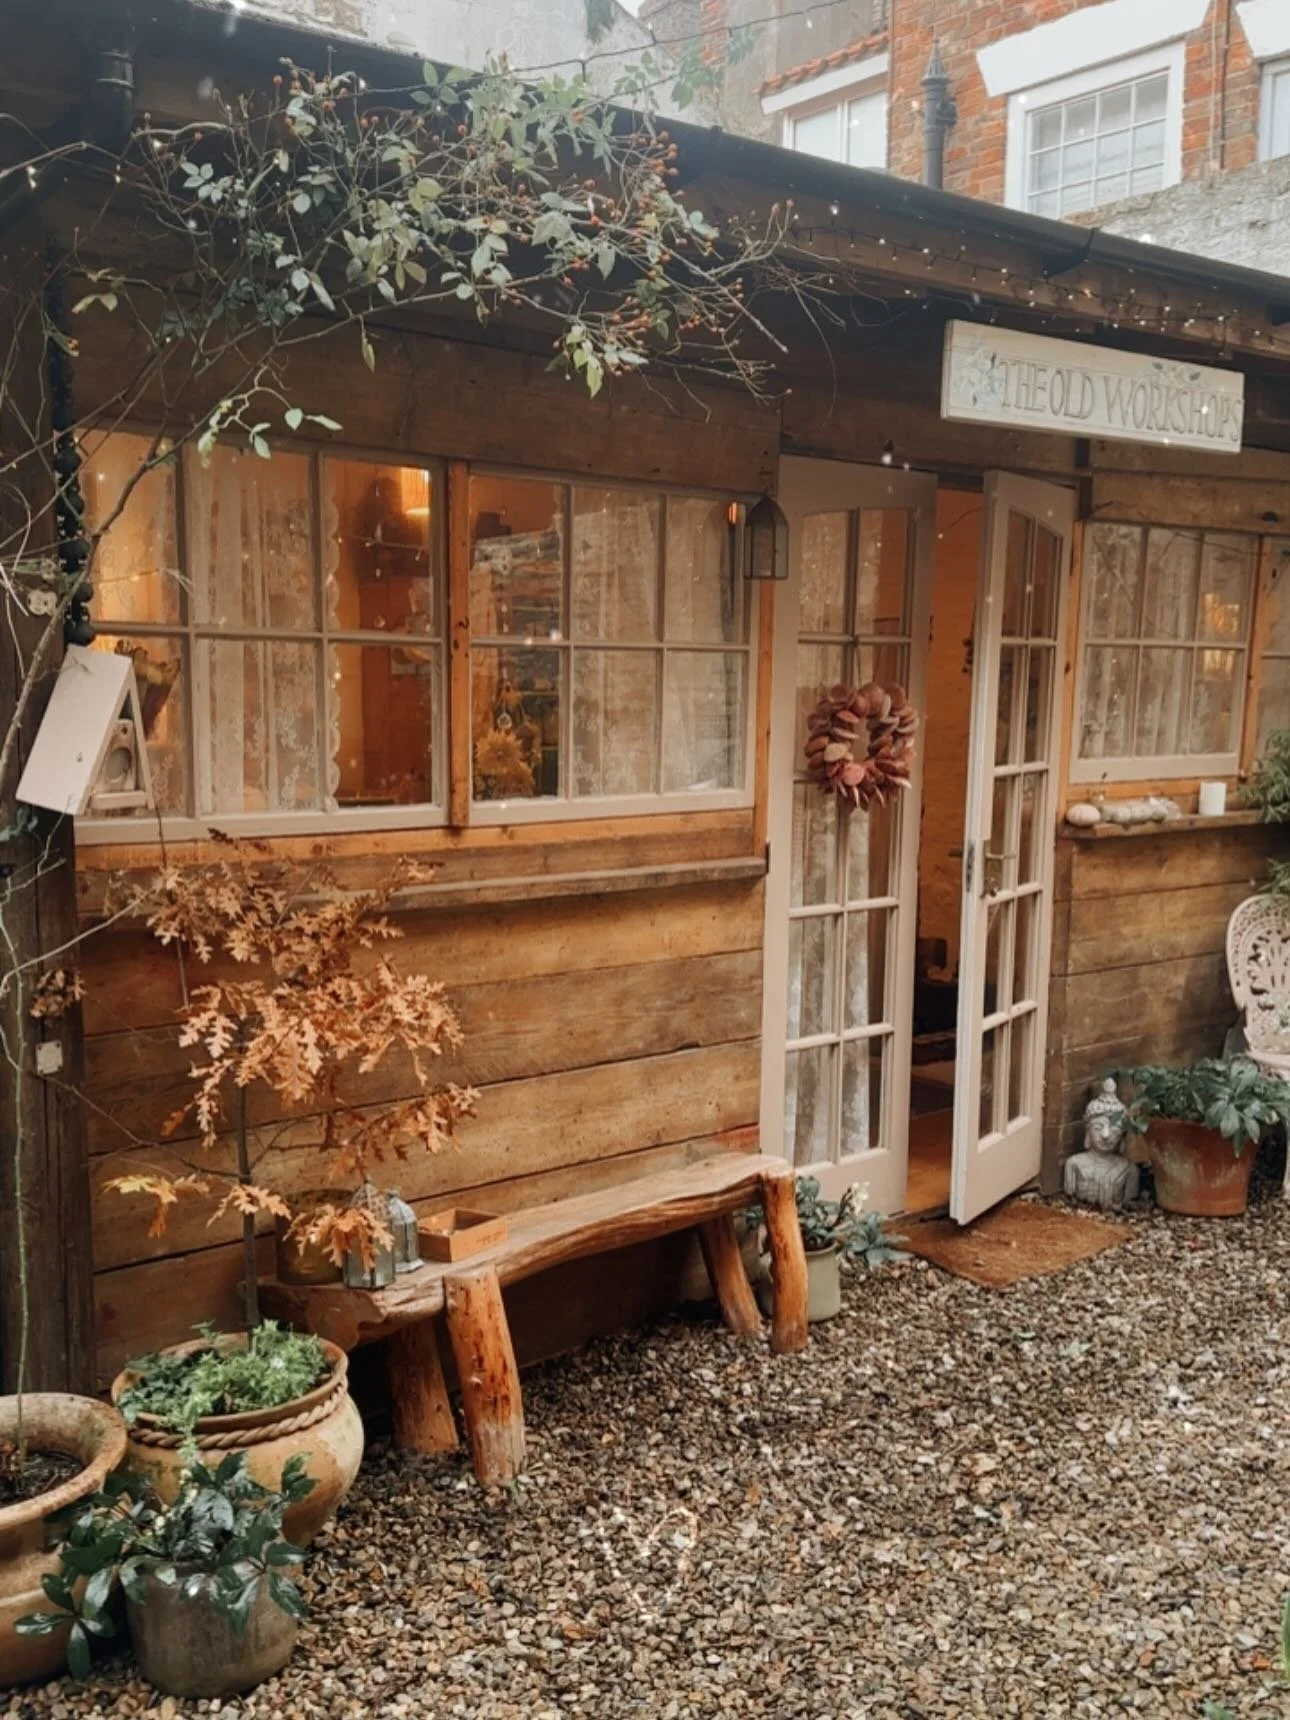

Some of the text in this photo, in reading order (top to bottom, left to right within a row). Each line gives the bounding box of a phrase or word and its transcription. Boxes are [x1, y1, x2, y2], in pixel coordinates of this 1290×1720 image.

[999, 360, 1243, 442] THE OLD WORKSHOPS
